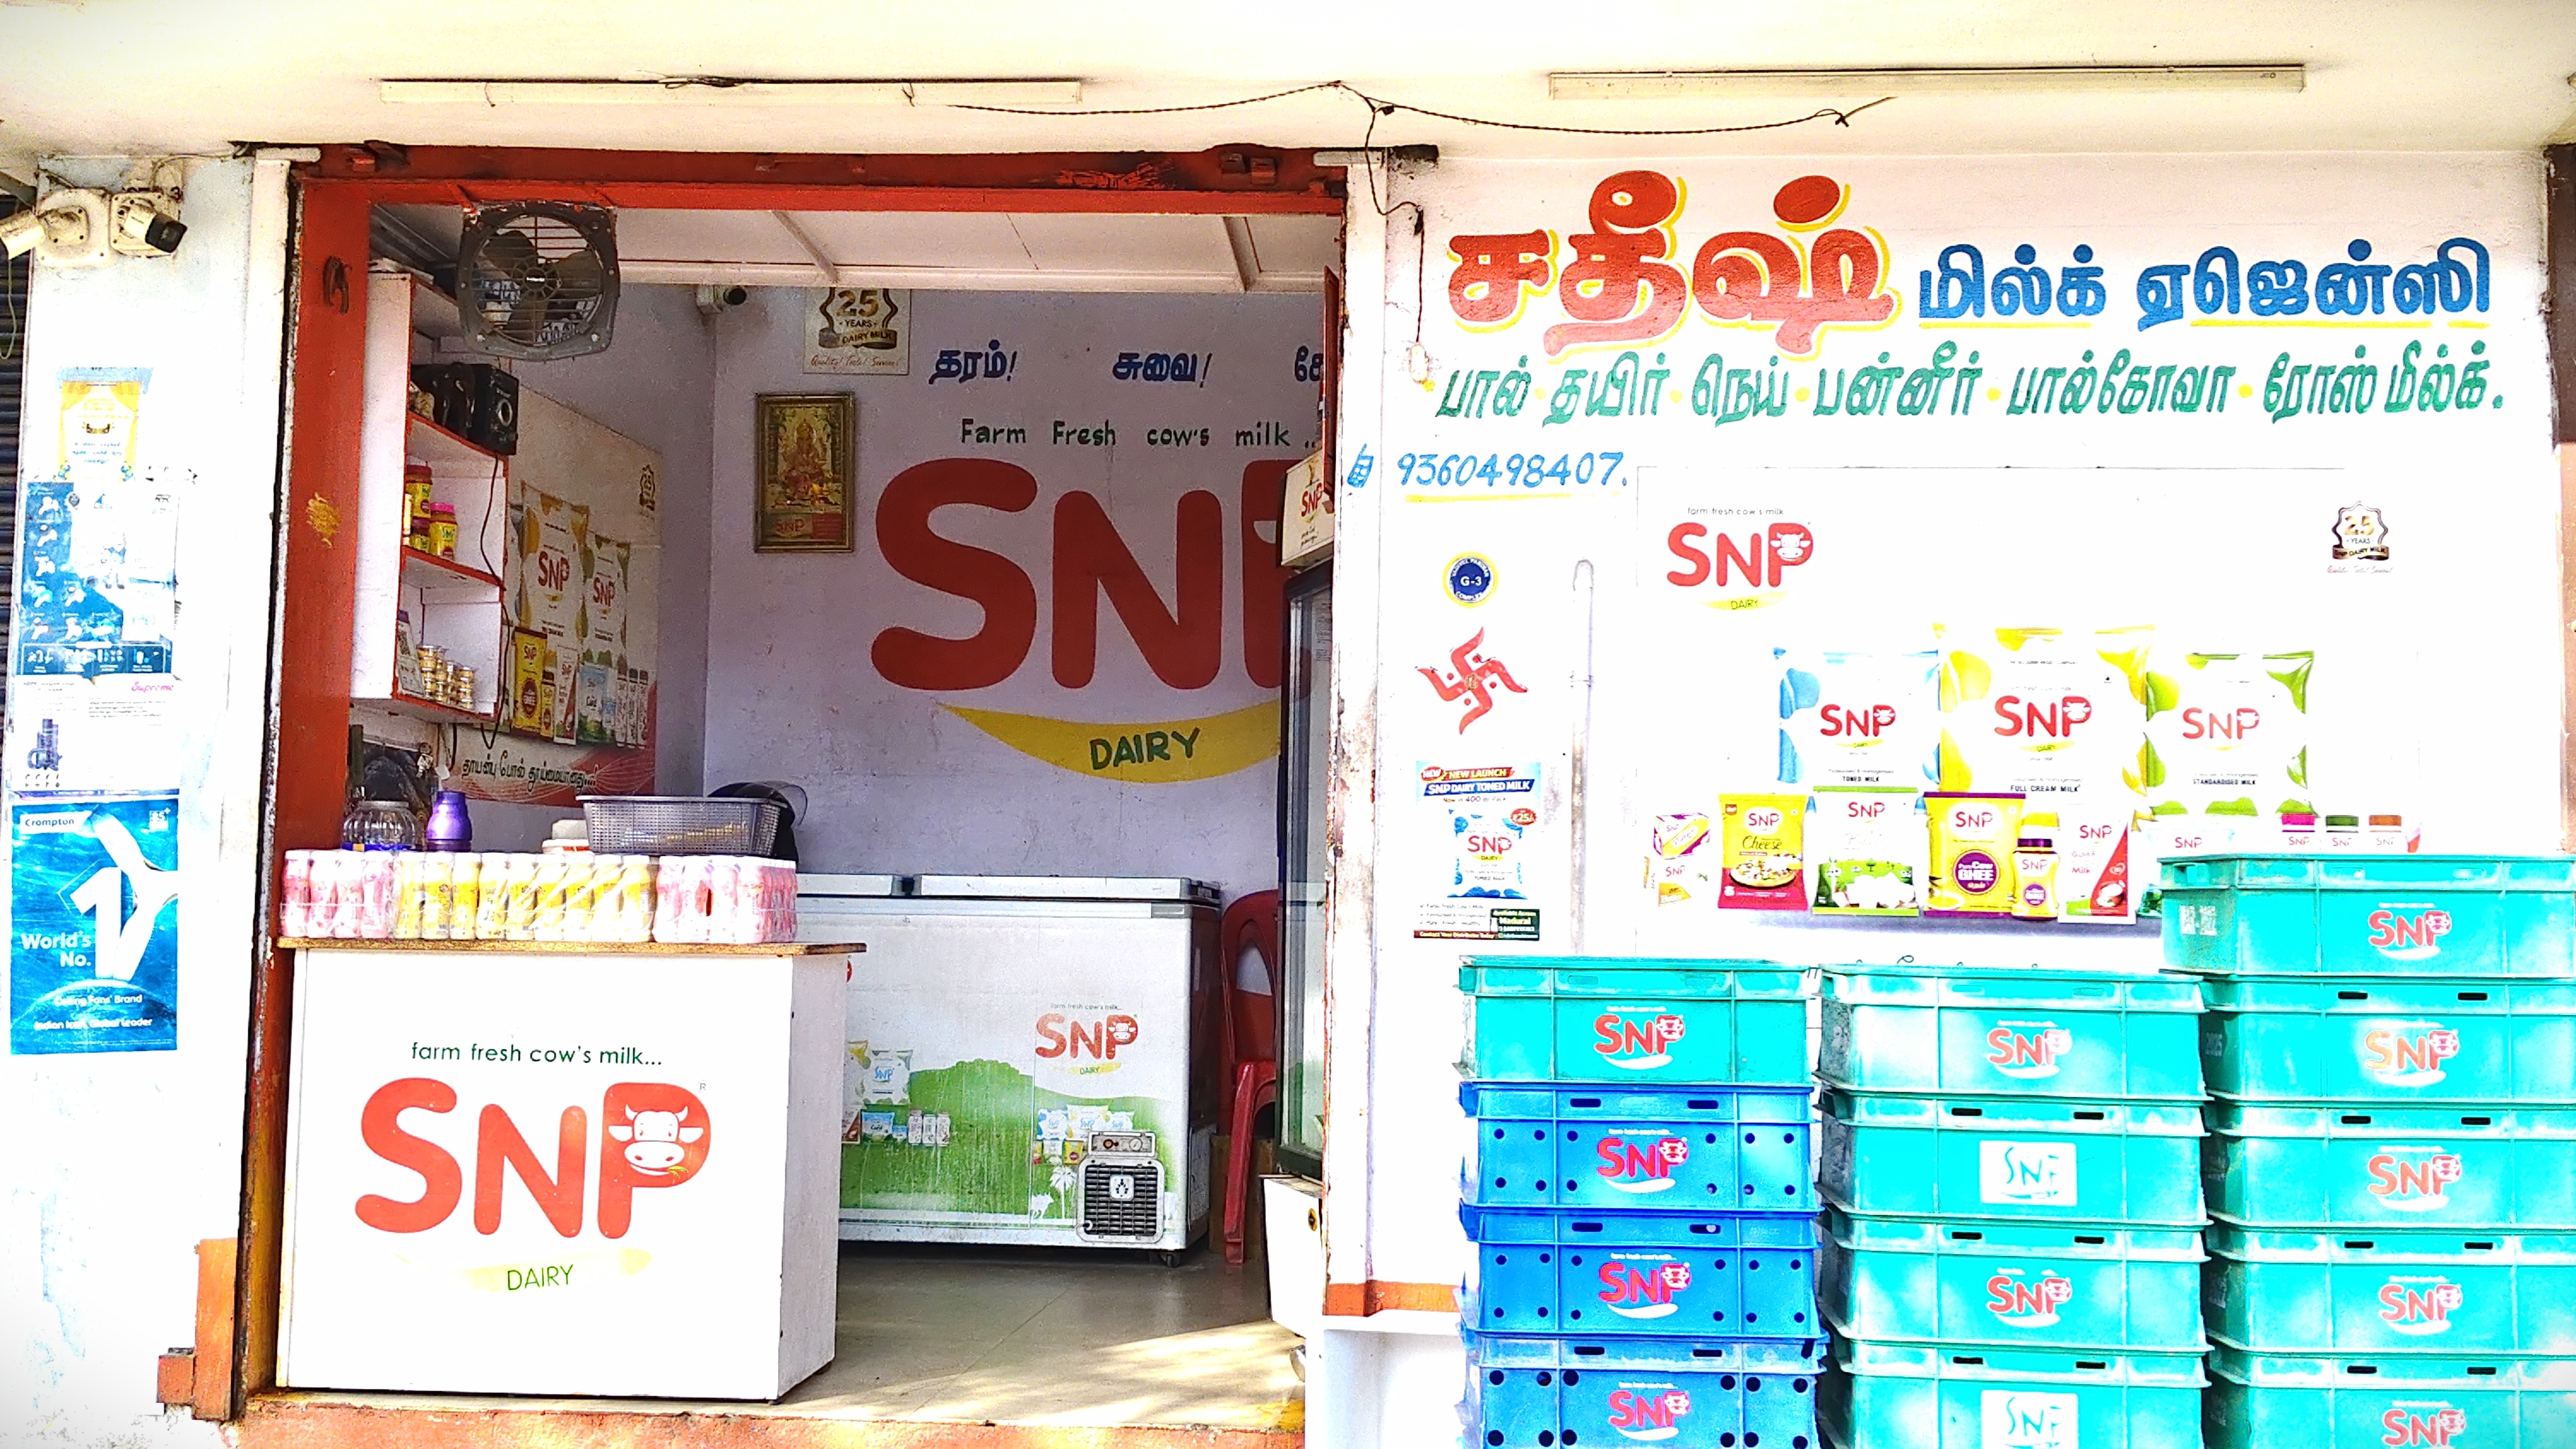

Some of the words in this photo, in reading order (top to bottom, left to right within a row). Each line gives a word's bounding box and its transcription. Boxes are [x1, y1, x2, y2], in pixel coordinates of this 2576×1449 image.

[1448, 170, 1894, 356] சதீஷ்
[1919, 243, 2106, 318] மில்க்
[2138, 238, 2490, 331] ஏஜென்ஸி
[836, 290, 879, 317] 25
[843, 332, 869, 344] DAIRY
[929, 340, 1018, 384] தரம்!
[1113, 352, 1213, 388] சுவை!
[1435, 355, 1532, 418] பால்
[1542, 352, 1670, 427] தயிர்
[1692, 353, 1789, 428] நெய்
[1813, 340, 1982, 416] பன்னீர்
[2007, 348, 2236, 416] பால்கோவா
[2264, 345, 2381, 424] ரோஸ்
[961, 418, 1026, 444] Farm
[1052, 419, 1117, 446] Fresh
[1146, 425, 1210, 447] cow's
[1301, 482, 1323, 518] SNP
[774, 518, 805, 533] SNP
[2345, 516, 2375, 536] 25
[1667, 522, 1814, 588] SNP
[538, 551, 570, 592] SNP
[1460, 575, 1482, 587] G-3
[593, 577, 616, 607] SNP
[1730, 599, 1758, 610] DAIRY
[523, 645, 538, 660] SNP
[1820, 704, 1896, 737] SNP
[1994, 695, 2092, 737] SNP
[2182, 707, 2260, 740] SNP
[1089, 728, 1200, 771] DAIRY
[499, 750, 526, 778] போல்
[1423, 769, 1441, 778] NEW
[1448, 770, 1469, 779] NEW
[1471, 769, 1507, 778] LAUNCH
[1428, 784, 1450, 794] SNP
[1475, 782, 1506, 792] TONED
[1506, 781, 1530, 791] MILK
[25, 818, 74, 827] Crompton
[1748, 813, 1780, 826] SNP
[1848, 801, 1885, 818] SNP
[1955, 811, 1993, 828] SNP
[1467, 835, 1512, 855] SNP
[1742, 835, 1783, 850] Cheese
[2079, 825, 2112, 839] SNP
[2174, 836, 2202, 849] SNP
[2288, 836, 2310, 846] SNP
[2332, 837, 2352, 847] SNP
[1666, 865, 1685, 877] SNP
[1958, 869, 1994, 881] GHEE
[2022, 859, 2048, 870] SNP
[21, 933, 91, 950] World's
[2368, 910, 2452, 947] SNP
[60, 952, 91, 967] No.
[114, 994, 143, 1004] Brand
[1035, 1013, 1138, 1060] SNP
[1594, 1014, 1685, 1055] SNP
[1987, 1028, 2072, 1065] SNP
[411, 1042, 460, 1061] farm
[471, 1043, 521, 1063] fresh
[530, 1045, 592, 1064] cow's
[599, 1046, 662, 1065] milk...
[2364, 1030, 2459, 1072] SNP
[875, 1067, 893, 1080] SNP
[1080, 1067, 1100, 1075] DAIRY
[355, 1077, 711, 1239] SNP
[1597, 1136, 1689, 1178] SNP
[2368, 1153, 2462, 1197] SNP
[507, 1264, 574, 1291] DAIRY
[1599, 1262, 1692, 1304] SNP
[1987, 1275, 2072, 1314] SNP
[2378, 1283, 2463, 1323] SNP
[1609, 1390, 1690, 1428] SNP
[2382, 1408, 2466, 1448] SNP
